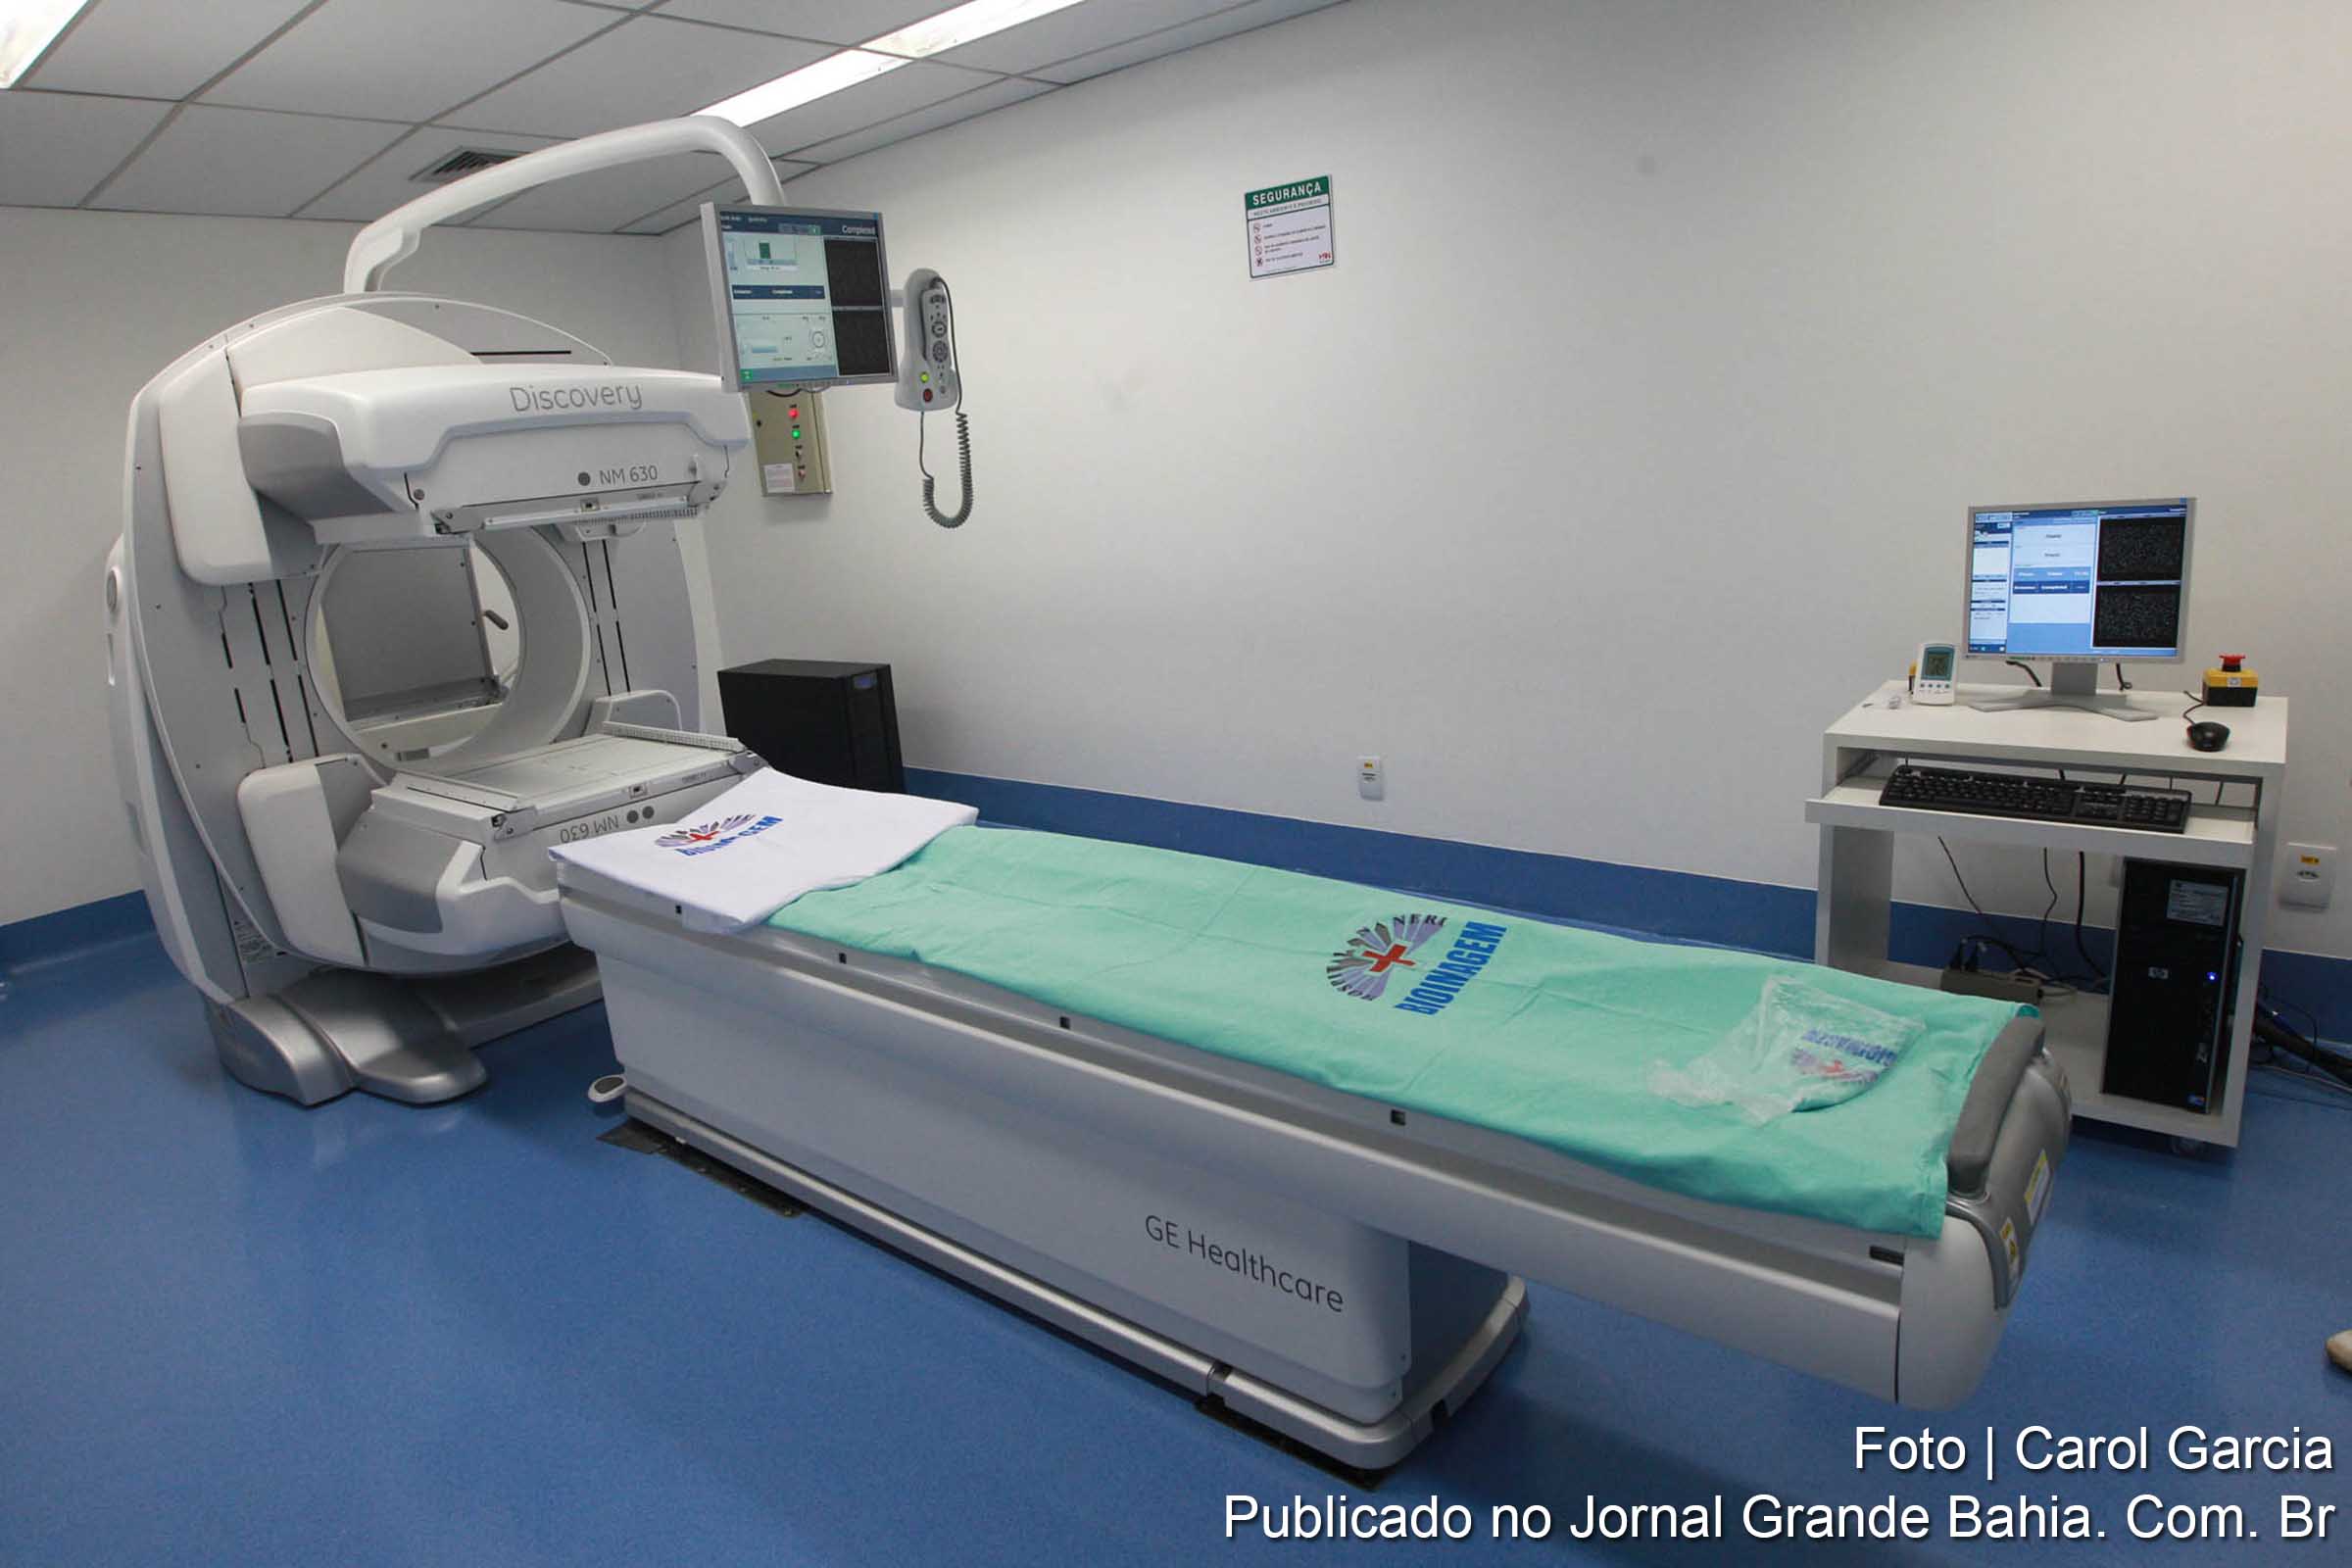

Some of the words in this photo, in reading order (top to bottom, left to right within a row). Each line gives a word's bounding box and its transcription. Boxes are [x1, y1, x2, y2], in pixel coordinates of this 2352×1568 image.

[1252, 182, 1322, 204] SEGURANÇA
[510, 383, 643, 412] Discovery
[599, 469, 625, 484] NM
[629, 466, 658, 483] 630
[560, 822, 589, 844] 630
[594, 815, 619, 833] NM
[1145, 1214, 1181, 1249] GE
[1188, 1229, 1345, 1313] Healthcare
